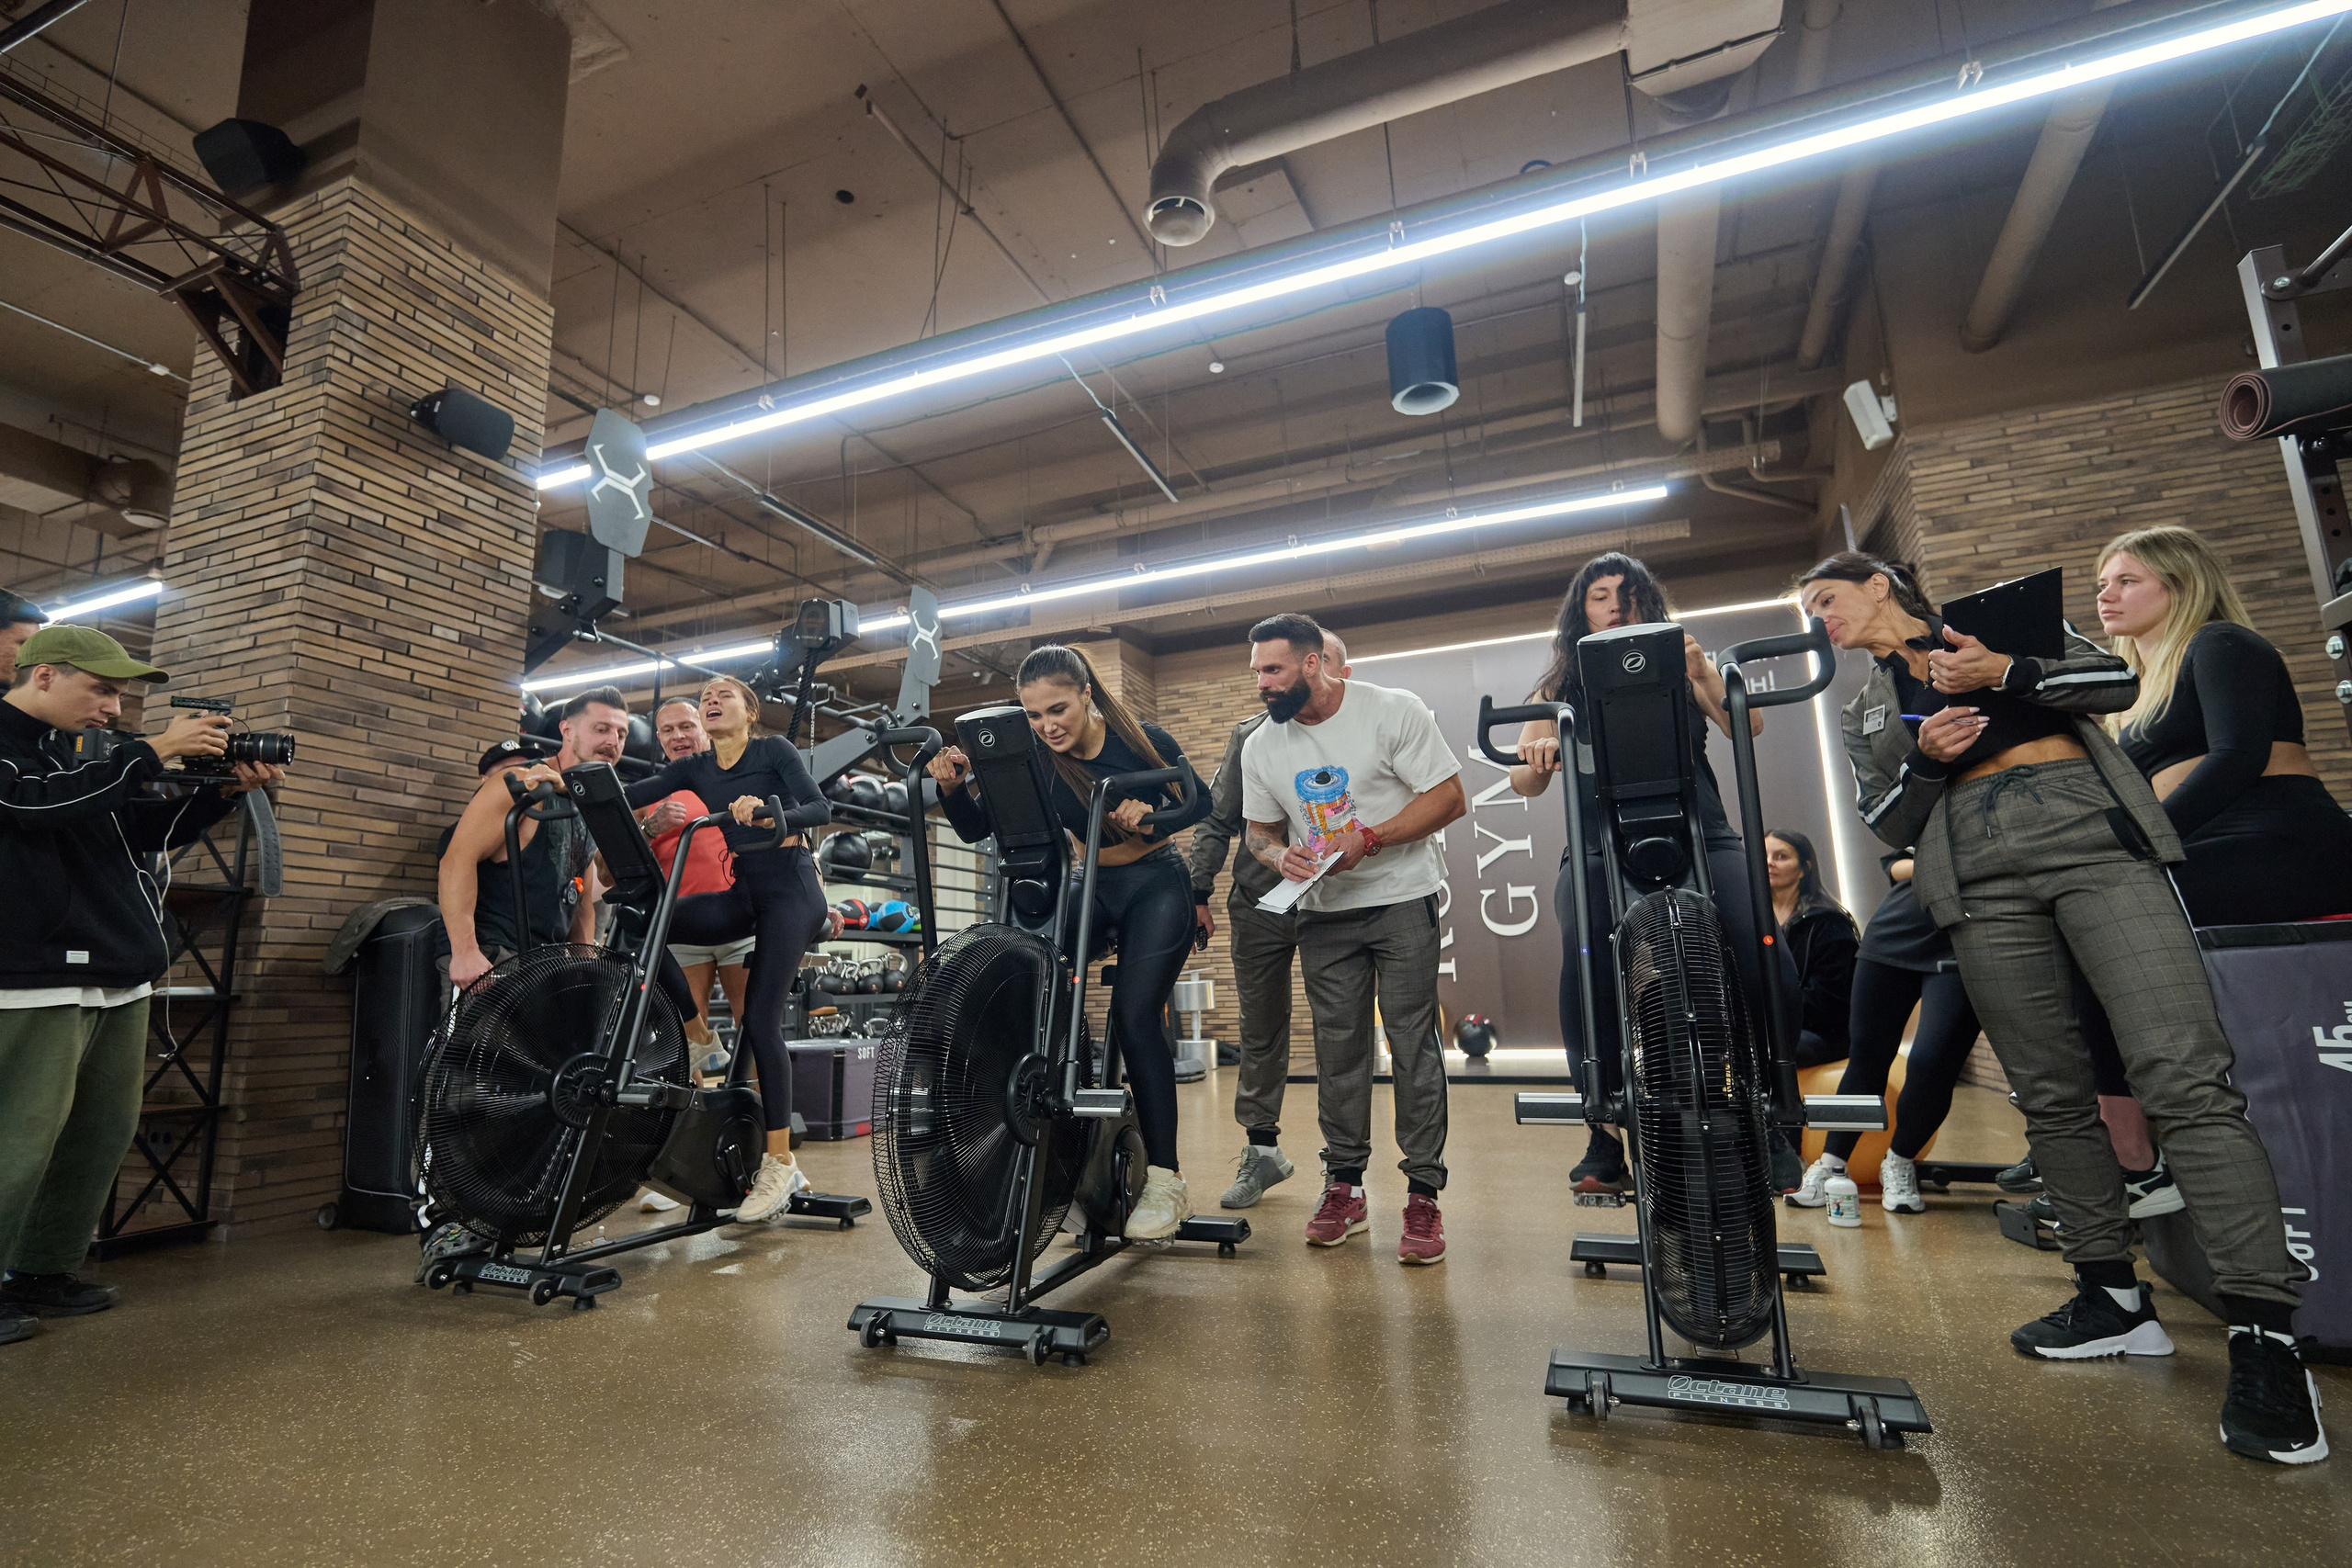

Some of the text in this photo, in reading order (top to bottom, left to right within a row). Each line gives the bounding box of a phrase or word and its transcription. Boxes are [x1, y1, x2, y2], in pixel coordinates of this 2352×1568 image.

[1467, 744, 1540, 937] GYM
[857, 1046, 876, 1061] SOFT
[925, 1312, 1002, 1330] Octane
[1668, 1374, 1787, 1400] Octane
